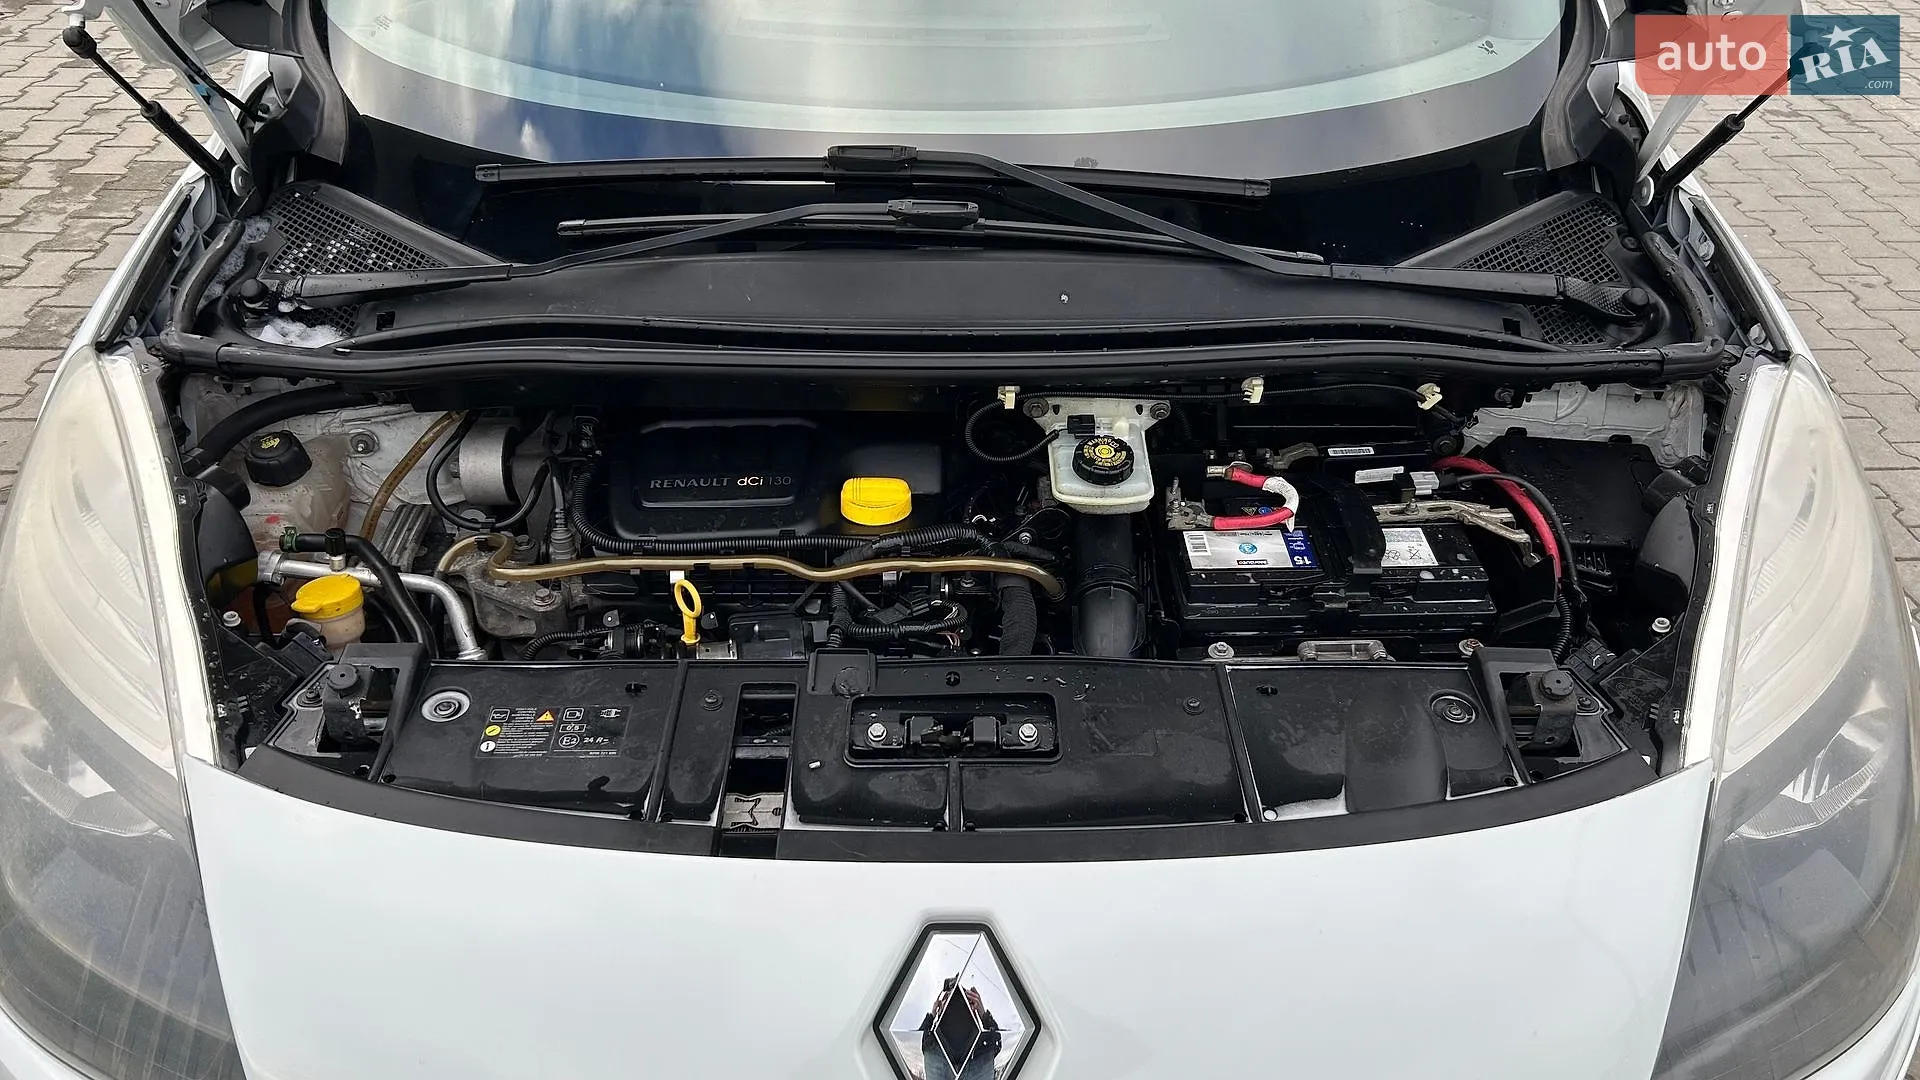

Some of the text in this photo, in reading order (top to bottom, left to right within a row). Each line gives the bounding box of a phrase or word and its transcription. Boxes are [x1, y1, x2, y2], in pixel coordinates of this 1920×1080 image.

[650, 476, 792, 489] RENAULT dCi 130
[562, 736, 577, 745] E2
